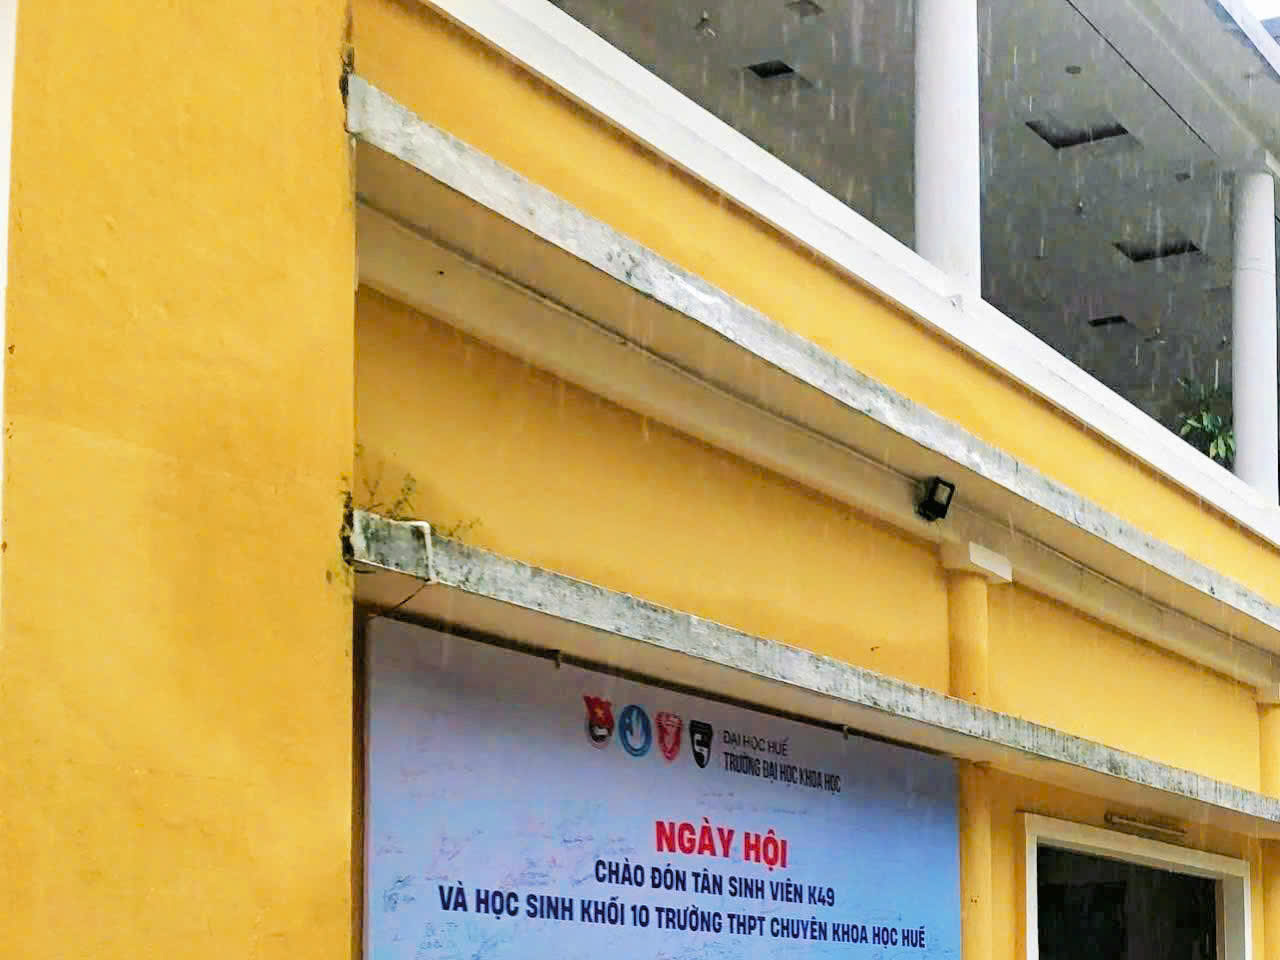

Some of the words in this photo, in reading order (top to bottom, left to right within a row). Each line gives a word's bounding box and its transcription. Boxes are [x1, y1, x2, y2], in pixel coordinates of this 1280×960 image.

[655, 816, 735, 859] NGÀY
[743, 829, 788, 872] HỘI
[595, 858, 645, 888] CHÀO
[651, 863, 688, 892] ĐÓN
[691, 867, 723, 897] TÂN
[728, 876, 765, 900] SINH
[769, 878, 804, 904] VIÊN
[808, 885, 836, 908] K49
[438, 880, 469, 912] VÀ
[475, 888, 520, 920] HỌC
[525, 893, 574, 922] SINH
[580, 896, 625, 926] KHỐI
[630, 904, 650, 928] 10
[655, 904, 723, 933] TRƯỜNG
[727, 913, 766, 937] THPT
[770, 916, 828, 941] CHUYÊN
[832, 922, 869, 945] KHOA
[872, 927, 899, 949] HỌC
[901, 925, 926, 949] HUẾ
